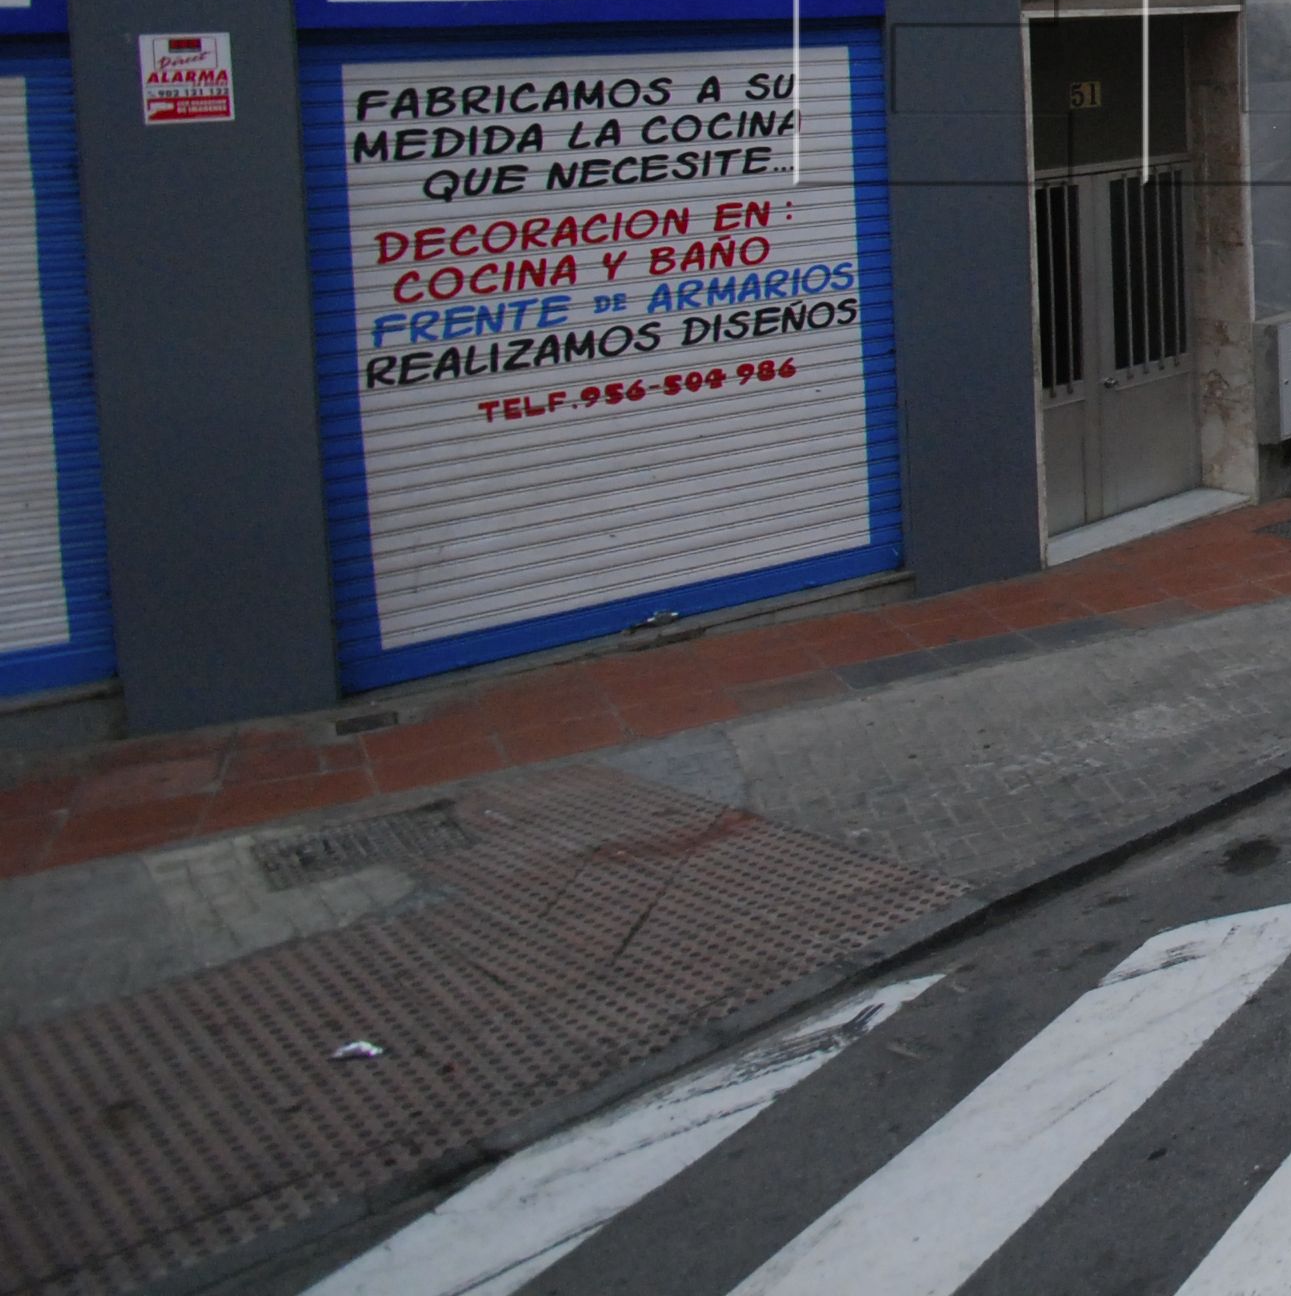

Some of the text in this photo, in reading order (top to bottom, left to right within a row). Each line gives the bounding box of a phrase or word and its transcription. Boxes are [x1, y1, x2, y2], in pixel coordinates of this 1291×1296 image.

[148, 70, 228, 83] ALARMA
[356, 72, 796, 122] FABRICAMOS A SU
[1071, 83, 1098, 108] 51
[353, 108, 801, 164] MEDIDA LA COCINA
[423, 164, 529, 202] QUE
[374, 207, 690, 265] DECORACION
[393, 235, 771, 304] COCINA Y BAÑO
[373, 261, 854, 348] FRENTE DE ARMARIOS
[366, 297, 858, 389] REALIZAMOS DISEÑOS
[736, 357, 797, 386] 986
